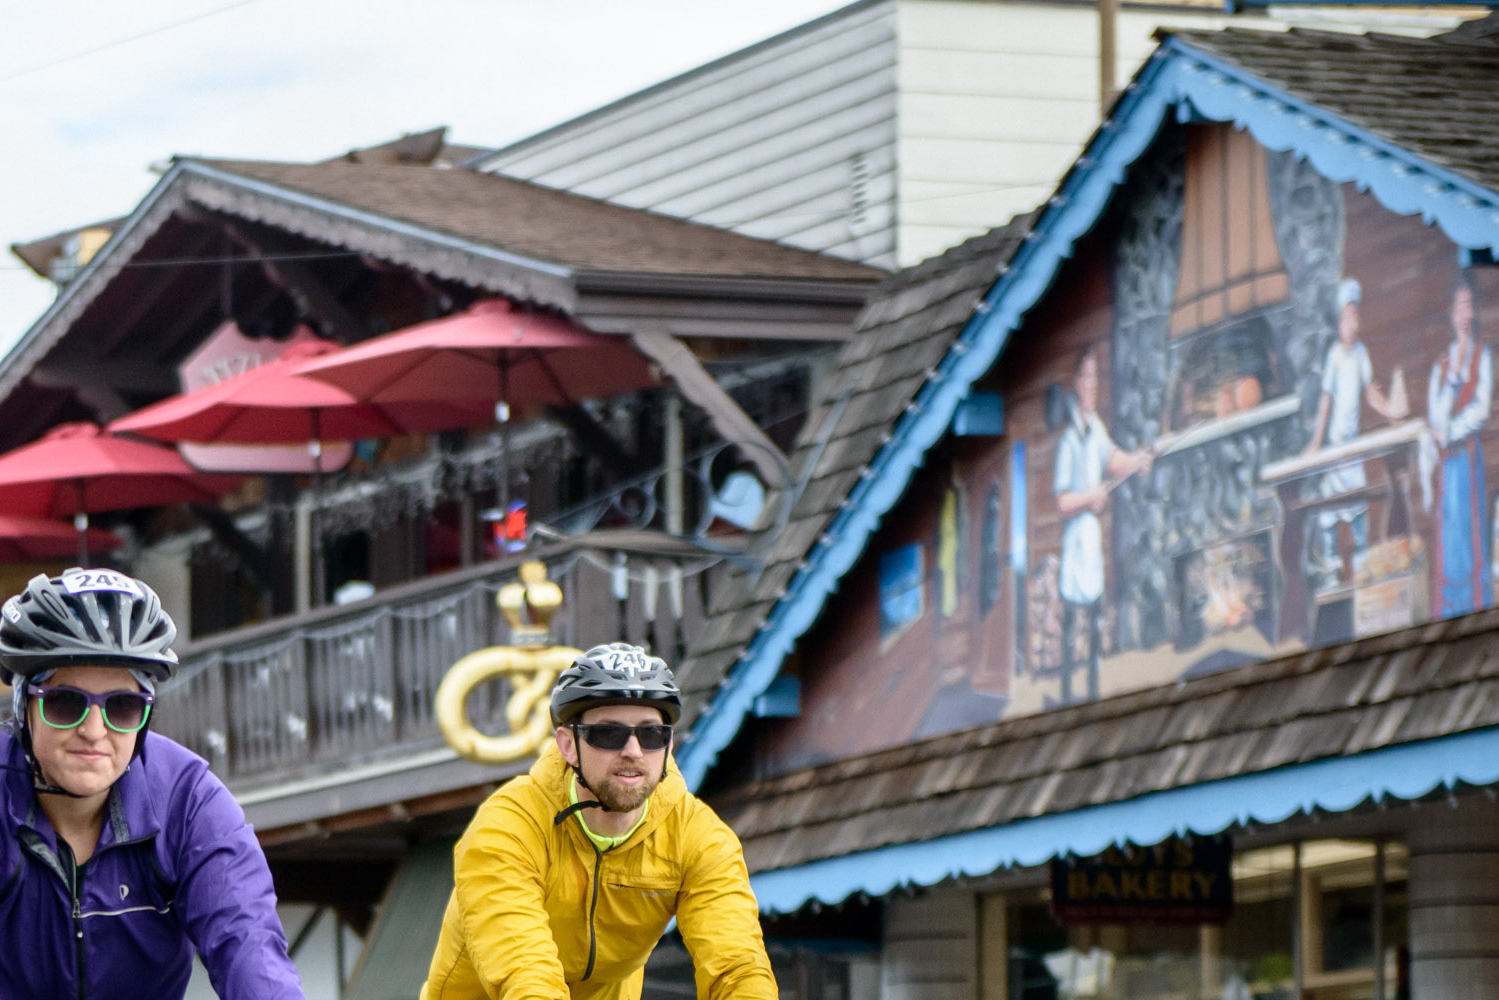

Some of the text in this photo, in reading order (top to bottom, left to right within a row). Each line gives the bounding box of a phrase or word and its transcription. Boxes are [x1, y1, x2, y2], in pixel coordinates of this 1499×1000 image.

[75, 574, 131, 588] 245
[609, 653, 646, 670] 246
[1067, 870, 1217, 898] BAKERY
